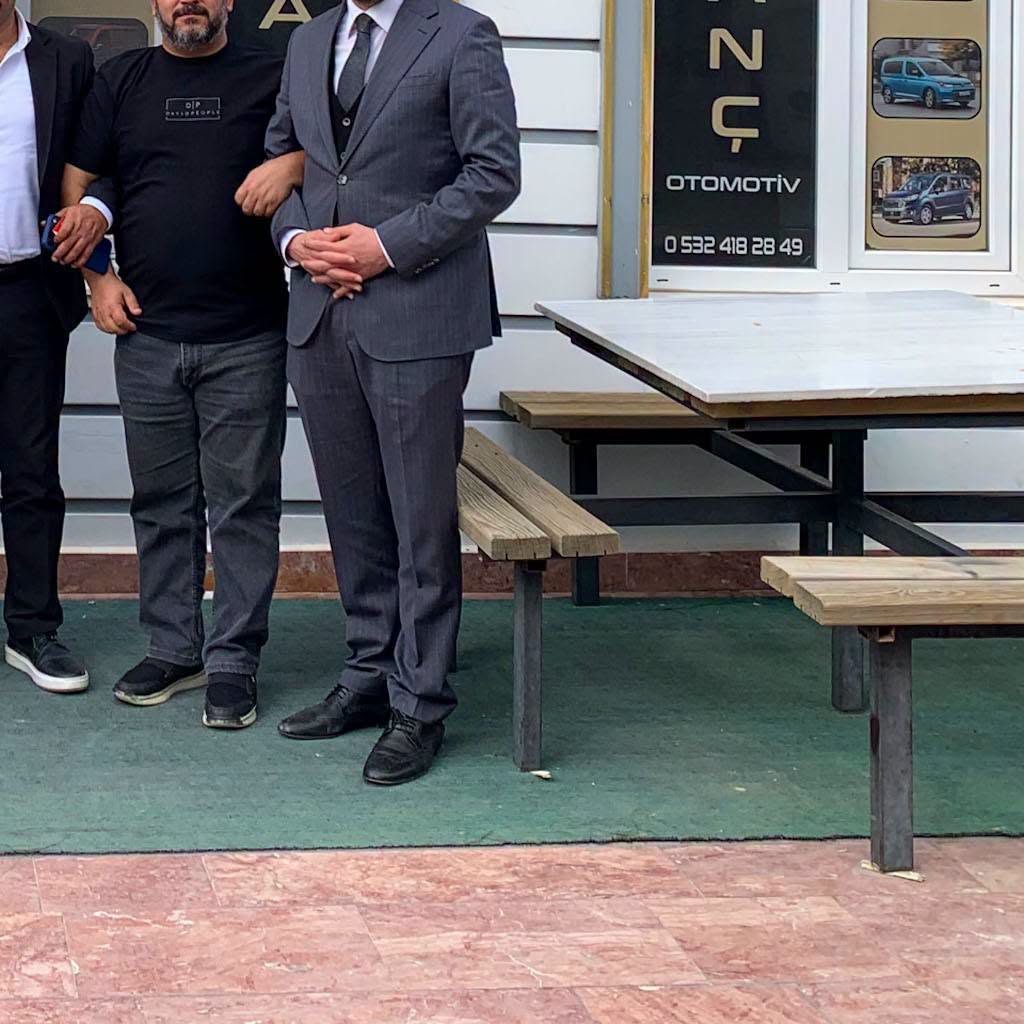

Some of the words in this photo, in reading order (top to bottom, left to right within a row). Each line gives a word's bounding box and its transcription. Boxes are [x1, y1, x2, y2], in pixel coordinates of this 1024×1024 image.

[666, 174, 801, 193] OTOMOTİV
[664, 235, 677, 253] 0
[680, 235, 716, 254] 532
[719, 236, 748, 255] 418
[751, 237, 776, 255] 28
[779, 238, 803, 256] 49
